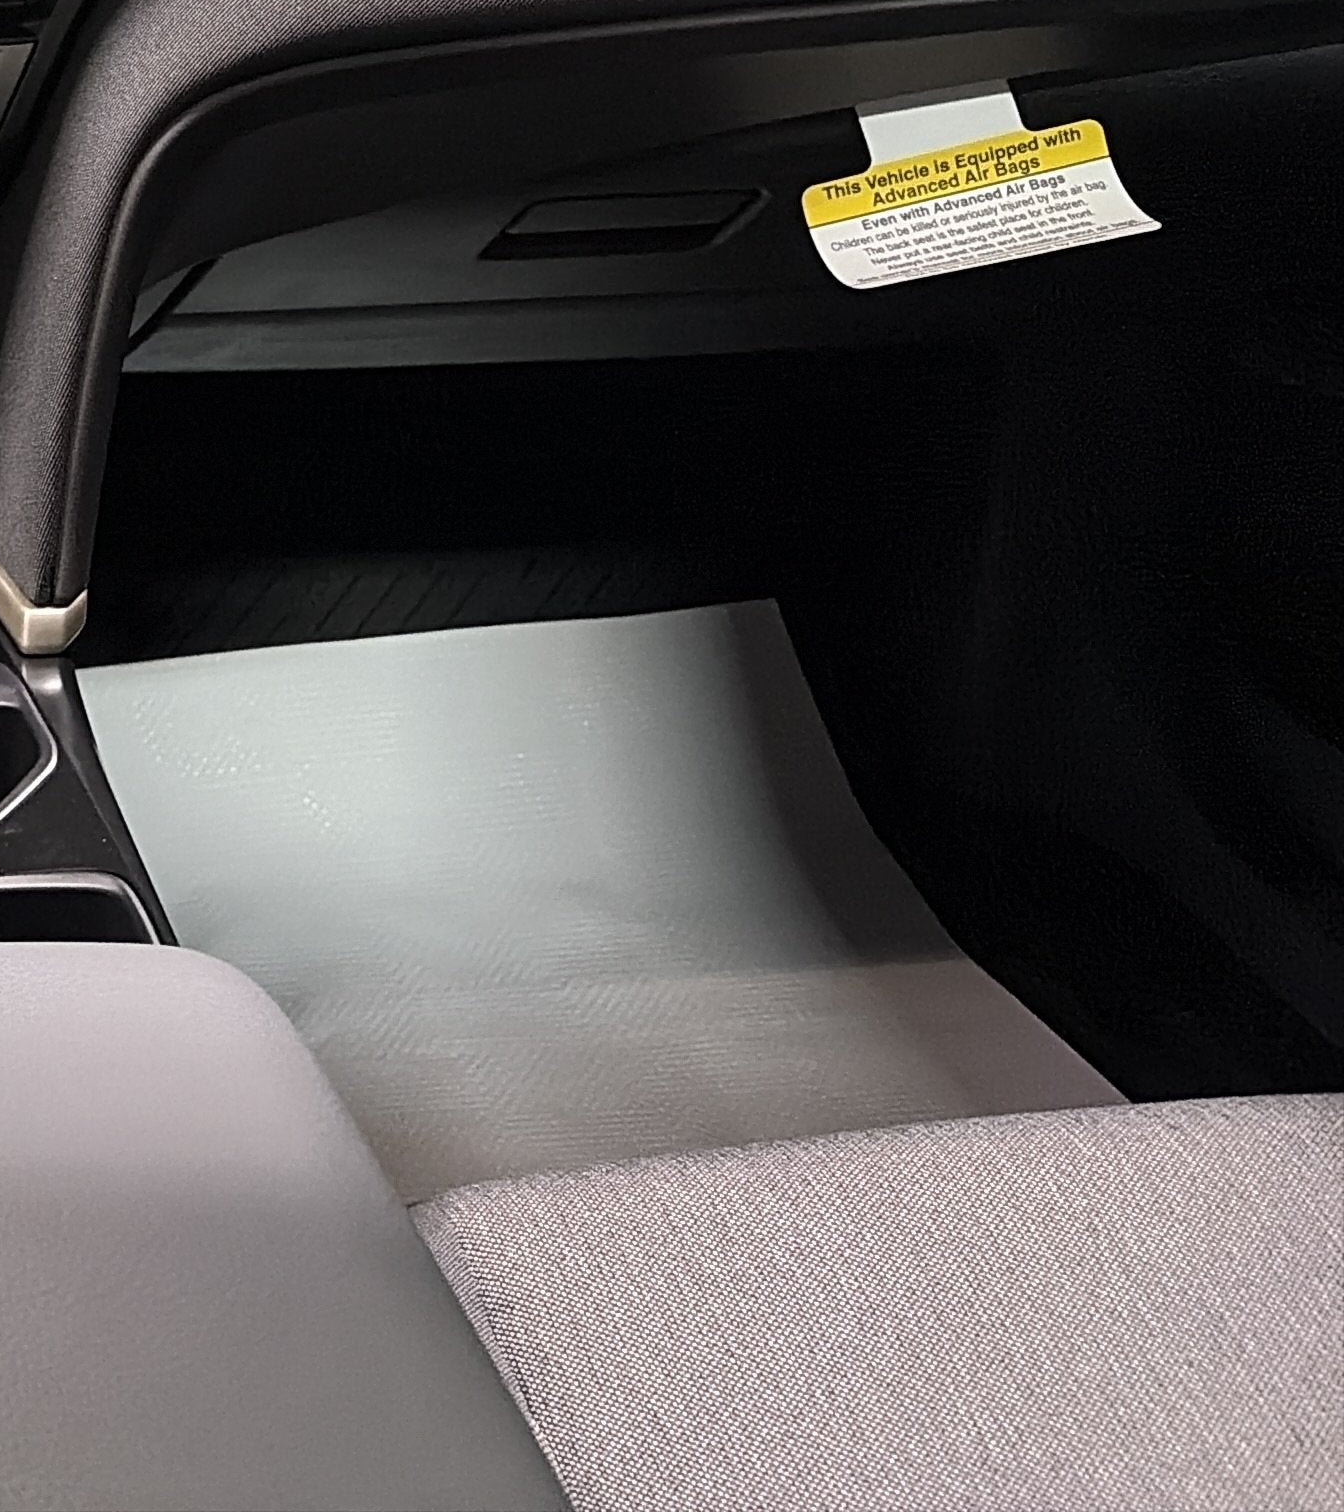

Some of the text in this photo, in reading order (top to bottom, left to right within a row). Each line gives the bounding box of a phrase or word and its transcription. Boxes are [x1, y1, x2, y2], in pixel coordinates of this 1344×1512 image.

[822, 181, 862, 200] This
[865, 165, 929, 189] Vehicle
[954, 136, 1039, 169] Equipped
[1043, 128, 1081, 147] with
[872, 157, 1040, 207] Advanced Air Bags
[831, 235, 874, 252] Children
[875, 230, 895, 241] can
[895, 227, 909, 237] be
[911, 219, 938, 233] killed
[940, 217, 951, 226] or
[953, 205, 999, 223] seriously
[1000, 197, 1035, 212] injured
[1035, 194, 1049, 206] by
[1052, 189, 1068, 199] the
[1070, 185, 1083, 195] air
[861, 174, 1066, 231] Even with Advanced Air Bags
[863, 244, 885, 256] The
[886, 239, 911, 251] back
[913, 234, 936, 245] seat
[937, 231, 947, 240] is
[947, 226, 965, 237] the
[966, 219, 1000, 233] safest
[1001, 213, 1027, 227] place
[1028, 207, 1042, 217] for
